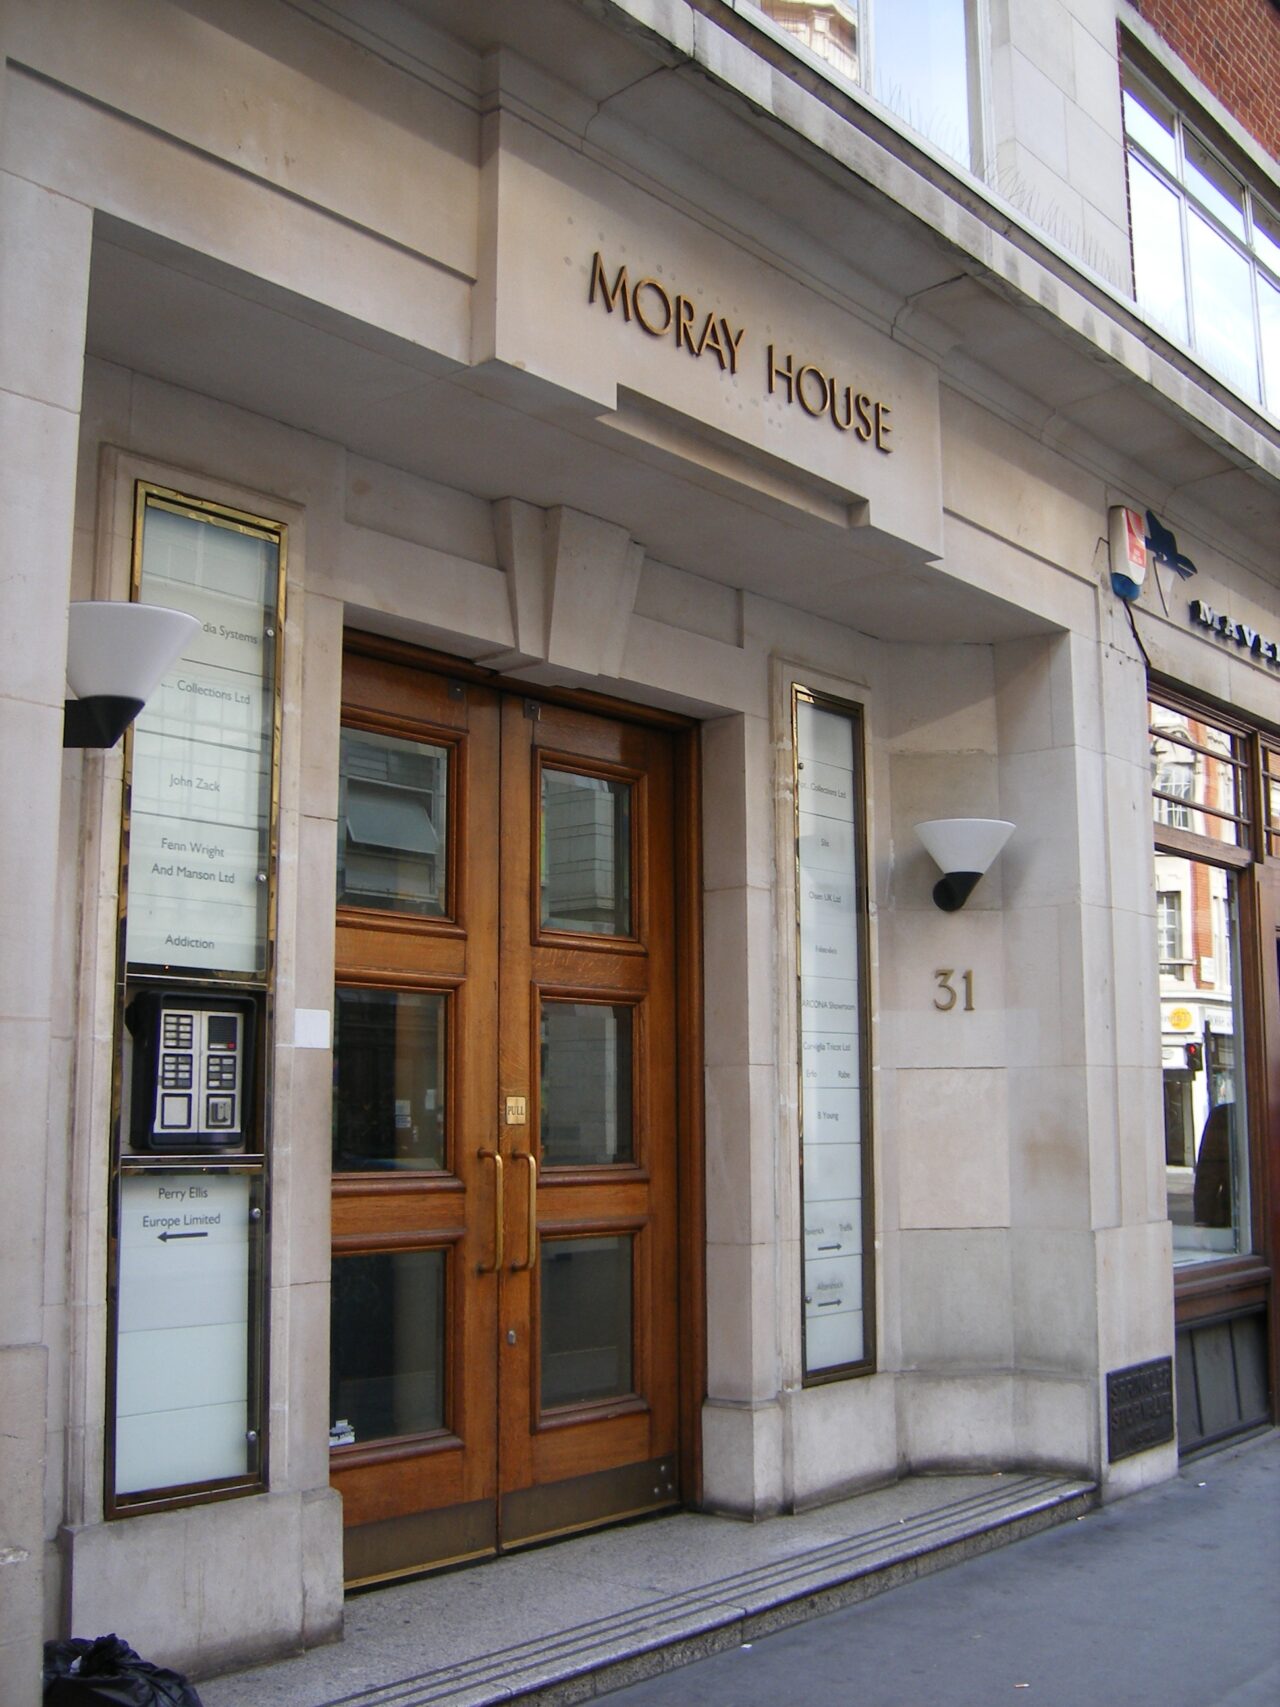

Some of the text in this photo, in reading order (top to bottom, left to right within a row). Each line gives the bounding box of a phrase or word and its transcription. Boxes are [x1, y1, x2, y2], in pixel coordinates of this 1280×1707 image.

[588, 251, 894, 454] MORAY HOUSE
[219, 625, 258, 645] Systems
[177, 680, 232, 701] Collections
[234, 692, 251, 704] Ltd
[169, 774, 220, 792] John Zack
[161, 838, 224, 860] Fenn Wright
[151, 863, 235, 884] And Manson Ltd
[164, 934, 215, 950] Addiction
[933, 968, 976, 1012] 31
[507, 1106, 525, 1116] PULL
[158, 1187, 208, 1201] Perry Ellis
[142, 1213, 221, 1229] Europe Limited
